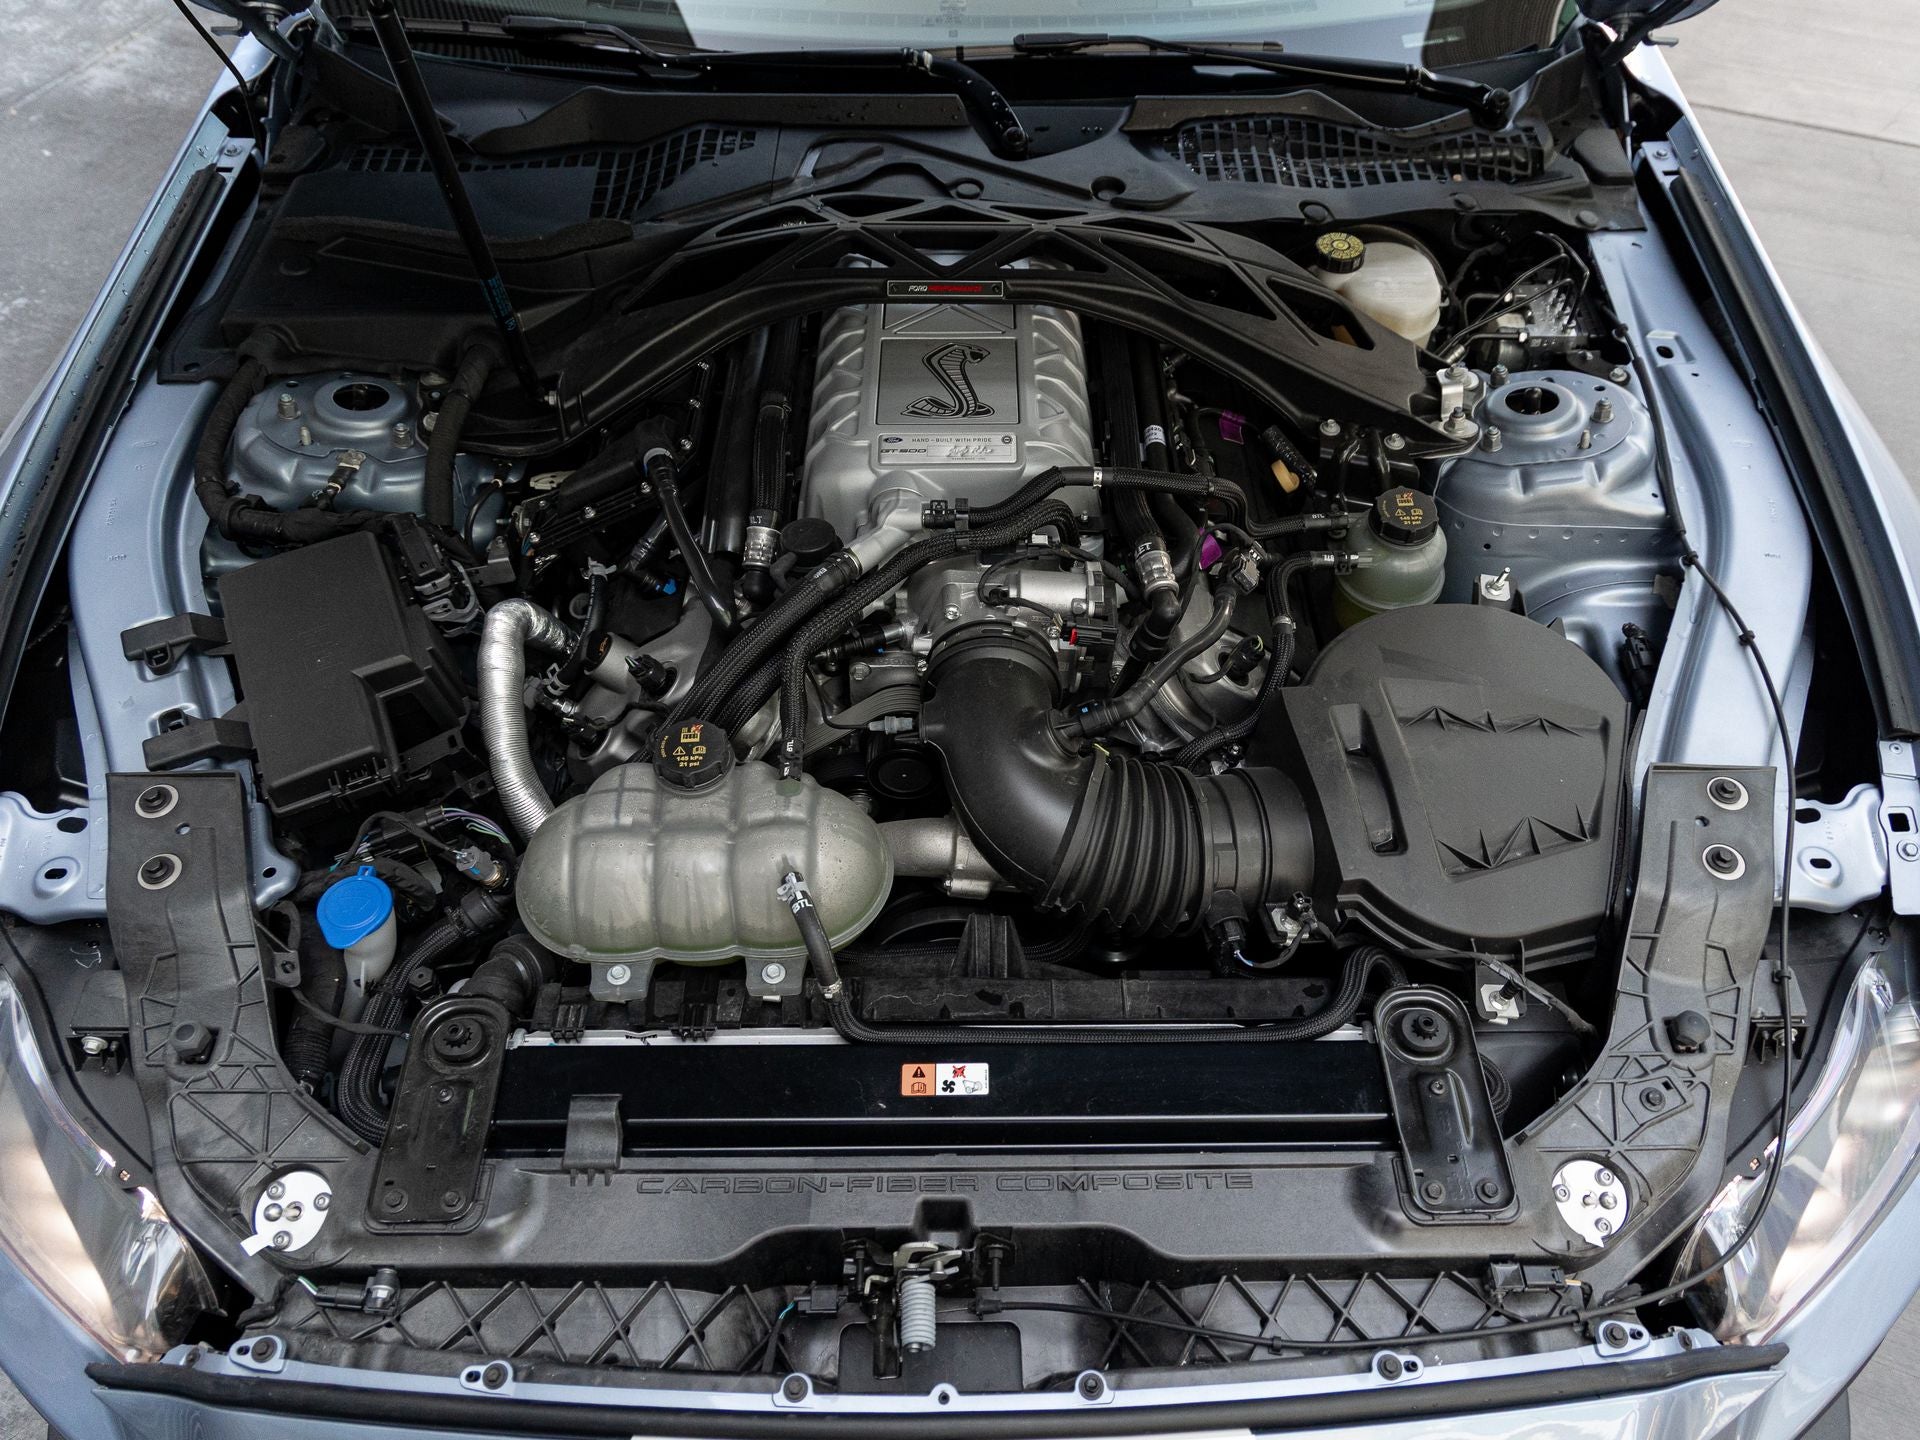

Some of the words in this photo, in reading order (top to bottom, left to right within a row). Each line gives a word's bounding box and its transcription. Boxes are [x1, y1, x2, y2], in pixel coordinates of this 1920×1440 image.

[791, 898, 813, 914] BTL
[636, 1175, 980, 1194] CARBON-FIBER
[996, 1172, 1254, 1192] COMPOSITE
